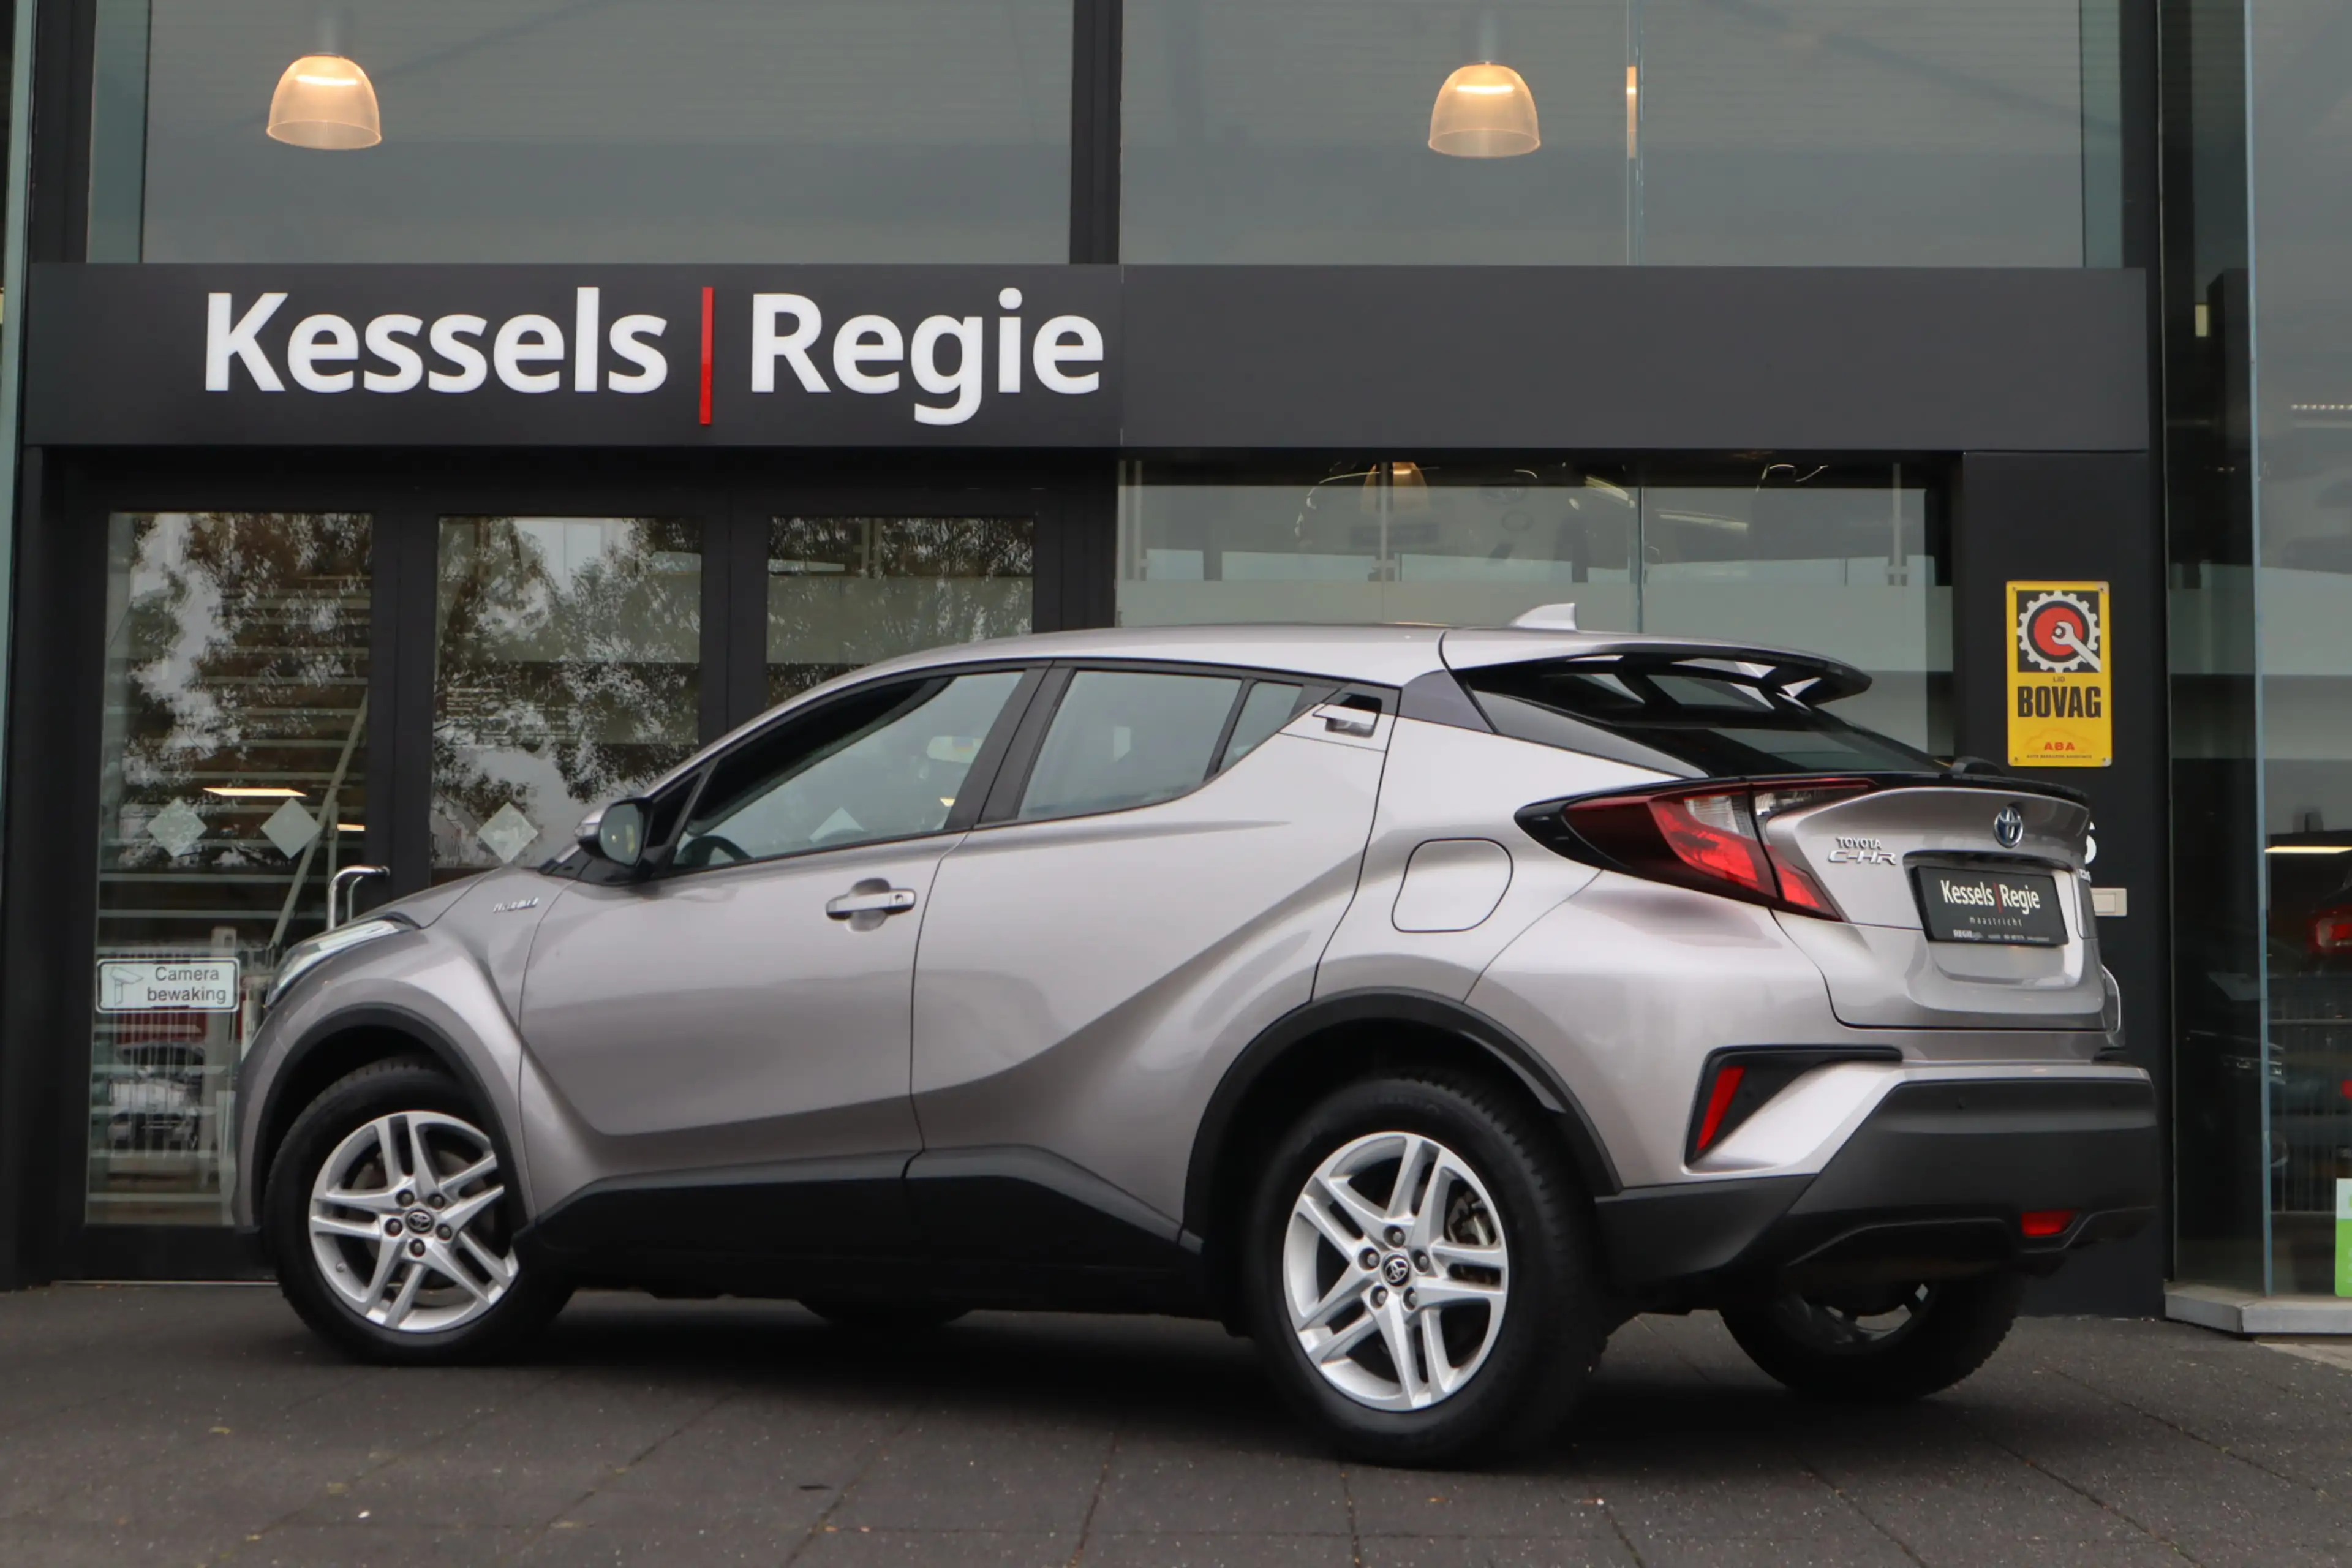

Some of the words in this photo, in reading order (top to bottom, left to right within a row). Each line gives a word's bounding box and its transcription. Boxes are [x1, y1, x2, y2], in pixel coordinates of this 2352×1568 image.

[206, 287, 667, 393] Kessels
[752, 288, 1104, 425] Regie
[2018, 686, 2102, 718] BOVAG
[2044, 742, 2075, 751] ABA
[1836, 836, 1882, 850] TOYOTA
[1828, 850, 1897, 865] C-HR
[1940, 880, 1994, 907] Kessels
[1999, 884, 2040, 915] Regie
[1970, 916, 2022, 927] maastricht
[155, 966, 219, 981] Camera
[147, 987, 227, 1005] bewaking
